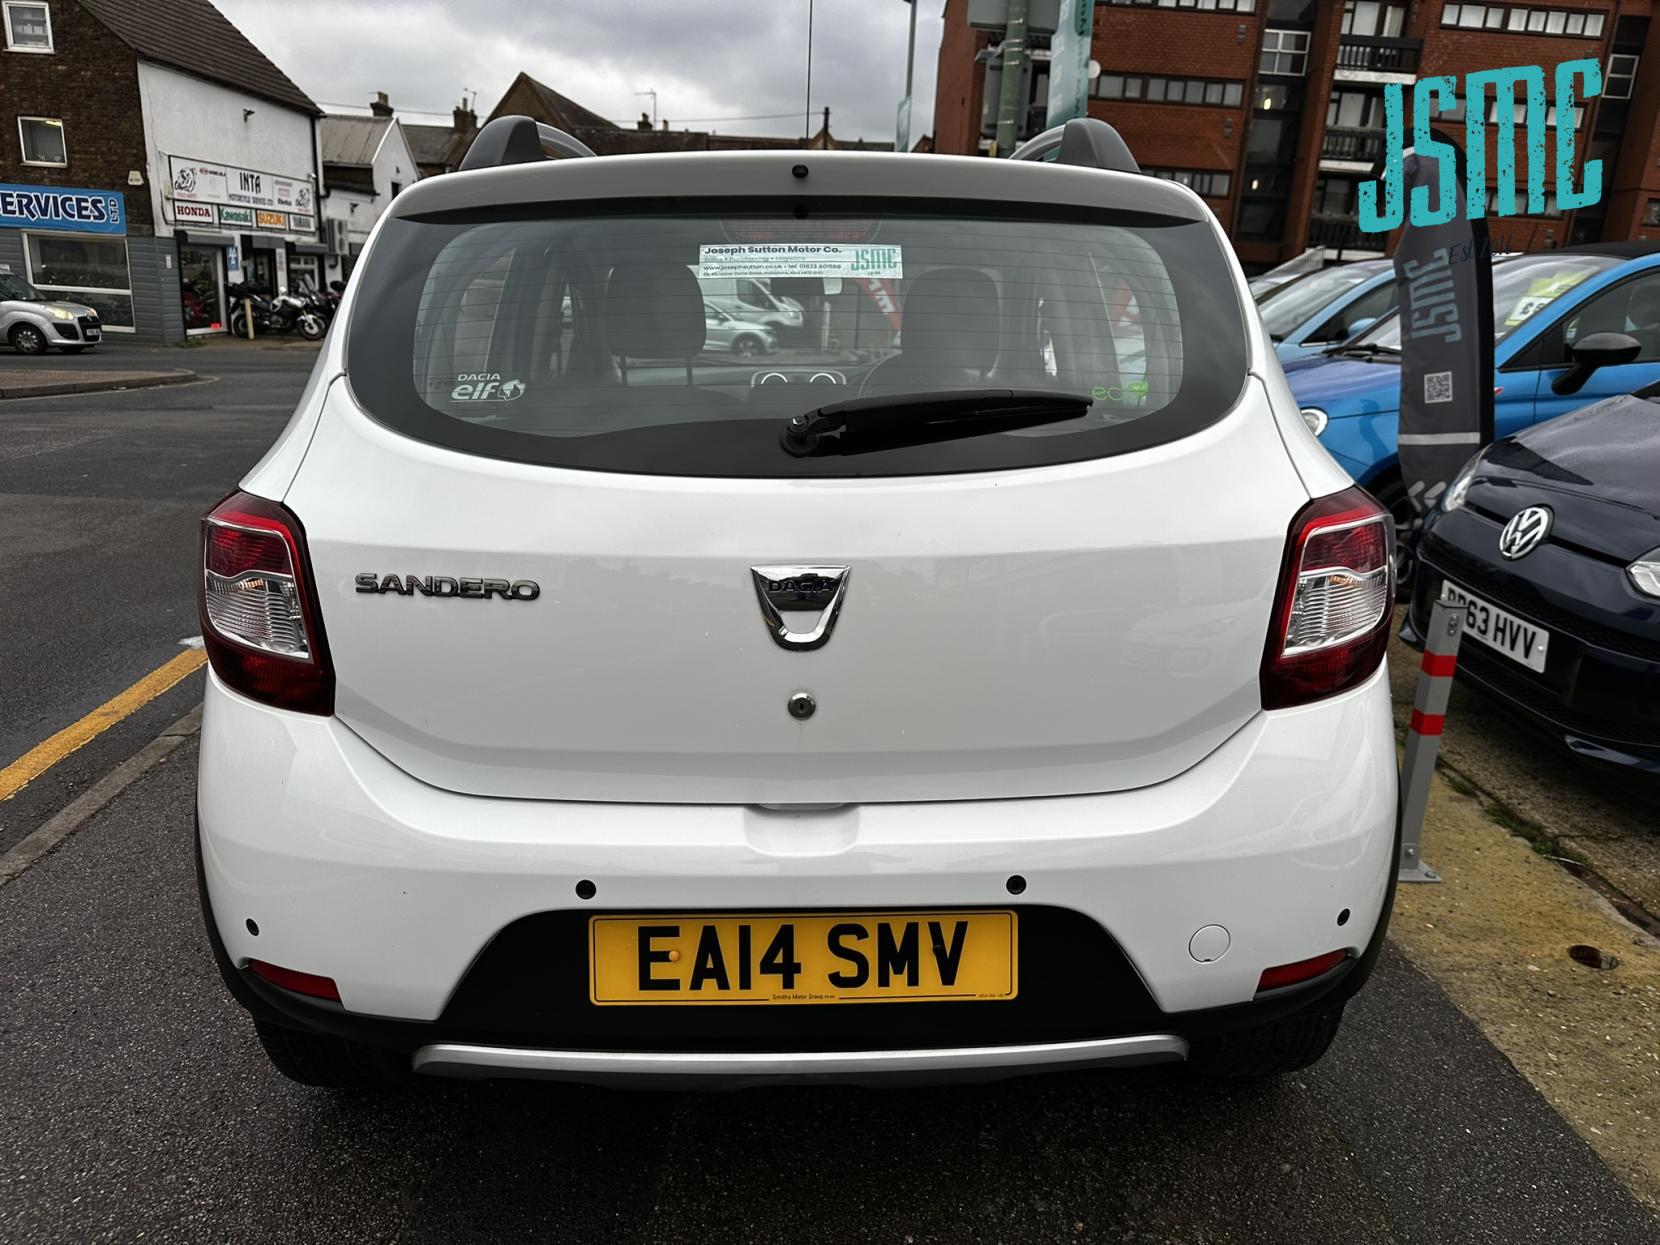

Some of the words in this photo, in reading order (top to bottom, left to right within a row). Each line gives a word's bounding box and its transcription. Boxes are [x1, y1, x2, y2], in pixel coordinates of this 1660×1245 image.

[239, 172, 262, 194] INTA
[0, 190, 107, 224] ERVICES
[108, 198, 120, 224] LTD
[177, 205, 211, 217] HONDA
[219, 207, 252, 223] Kawasaki
[257, 211, 286, 226] SUZUKI
[704, 246, 747, 256] Joseph
[747, 246, 787, 254] Sutton
[788, 246, 822, 254] Motor
[823, 246, 843, 254] Co.
[850, 248, 898, 271] JSMC
[1403, 247, 1462, 344] JSMC
[458, 373, 500, 381] DACIA
[451, 382, 500, 400] elf
[355, 572, 541, 601] SANDERO
[768, 580, 834, 593] DACIA
[1492, 613, 1537, 659] HVV
[638, 923, 802, 991] EA14
[827, 921, 969, 989] SMV
